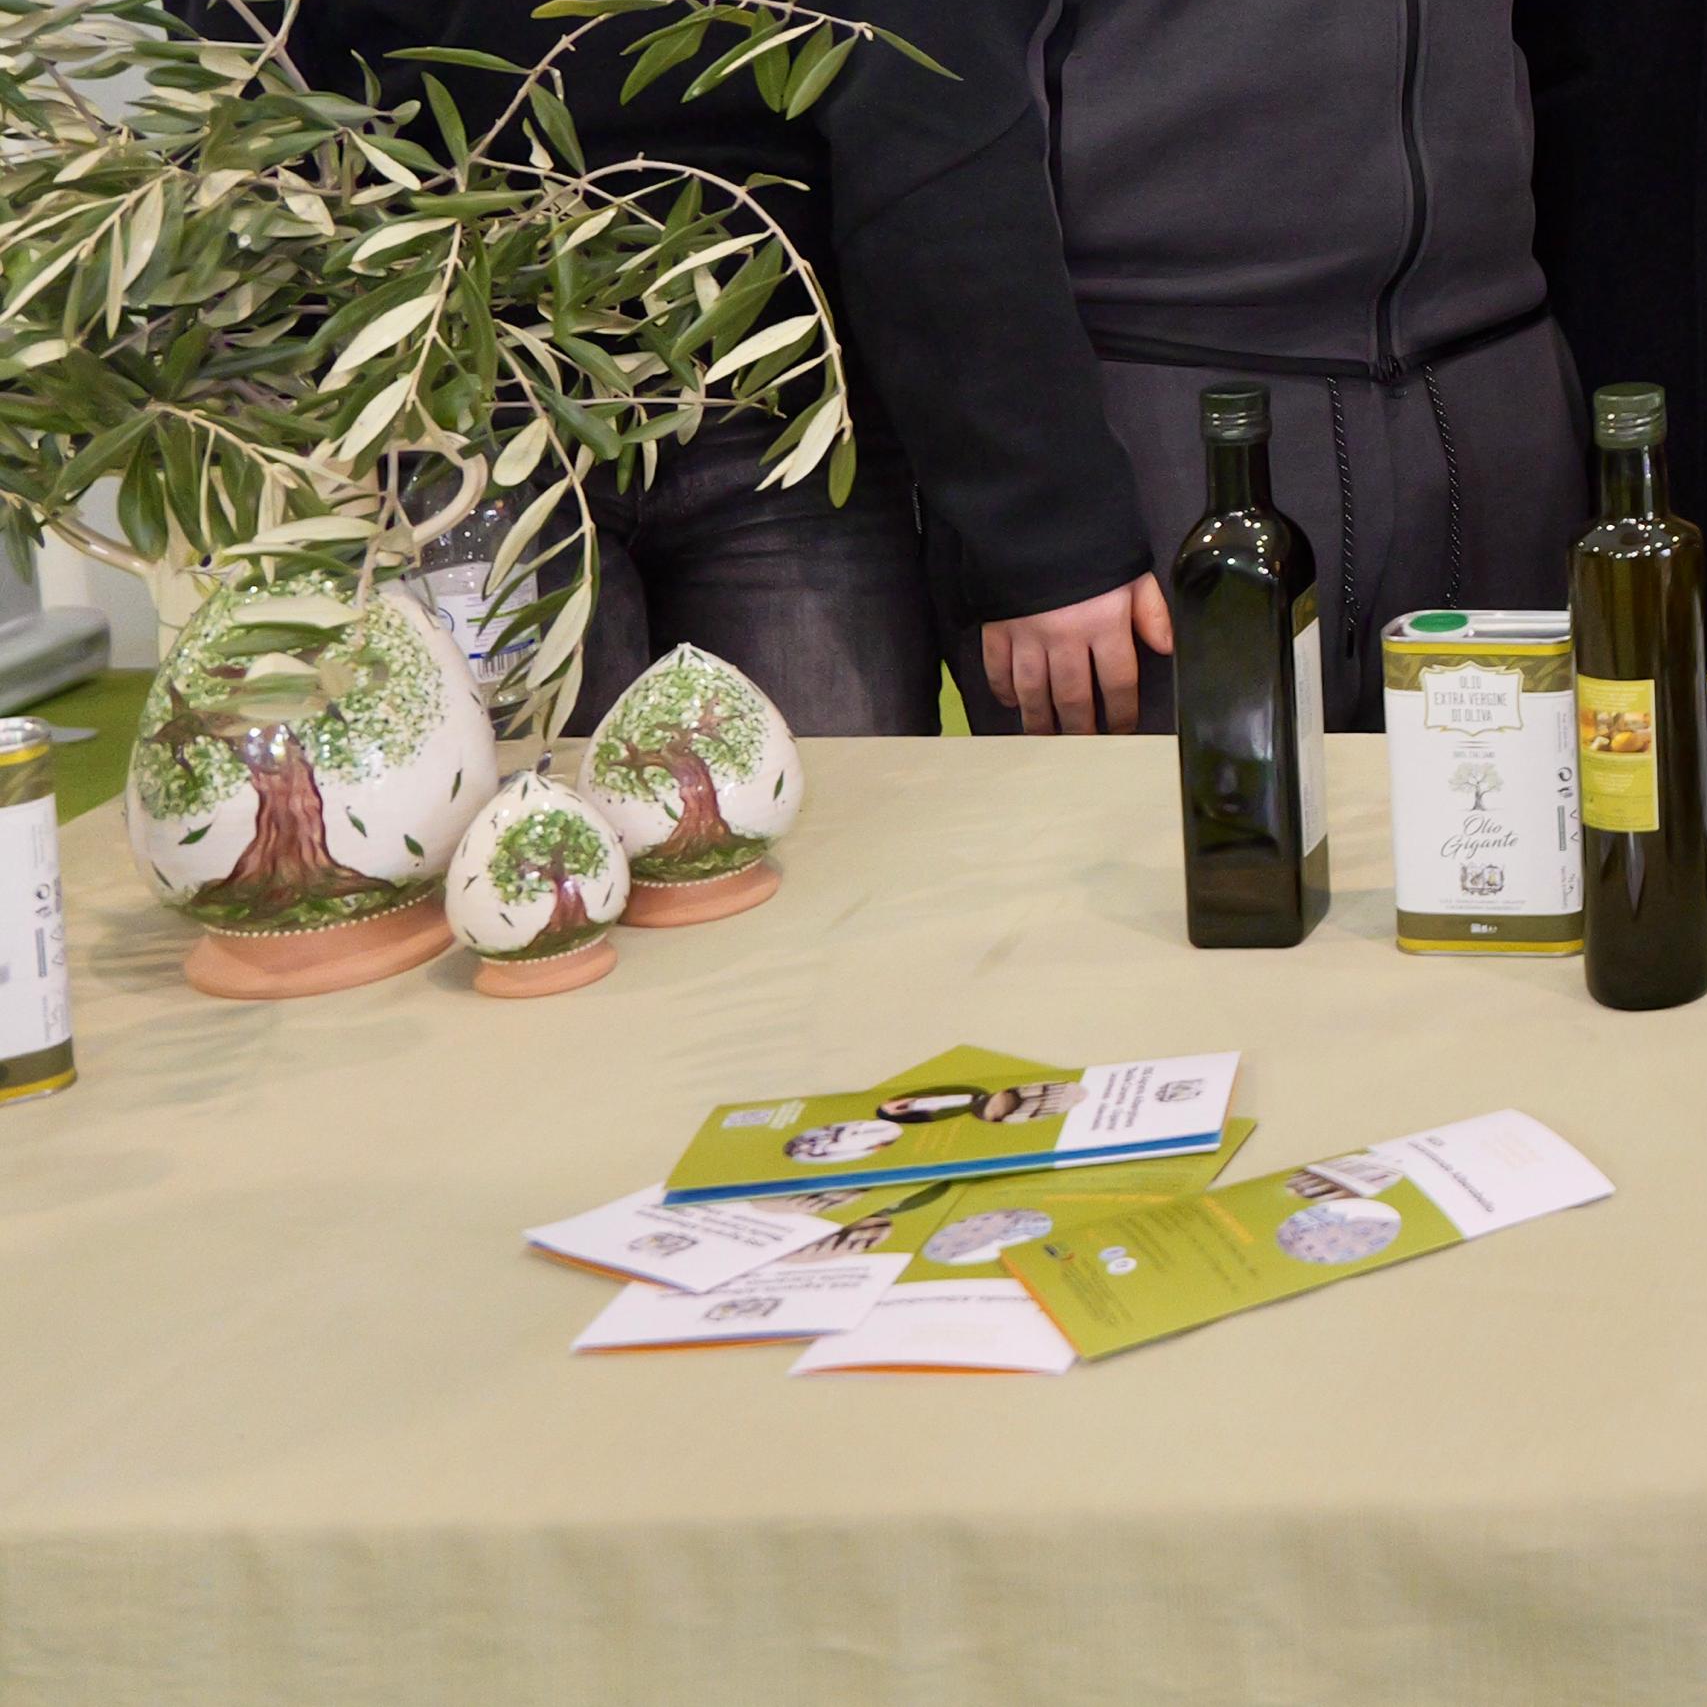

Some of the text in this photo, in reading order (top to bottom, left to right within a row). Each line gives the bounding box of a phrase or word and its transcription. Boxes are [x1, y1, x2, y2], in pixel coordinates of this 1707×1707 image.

[1460, 675, 1481, 689] OLIO
[1434, 691, 1508, 706] EXTRA VERGINE
[1463, 814, 1502, 836] Olio
[1440, 830, 1519, 859] Gigante
